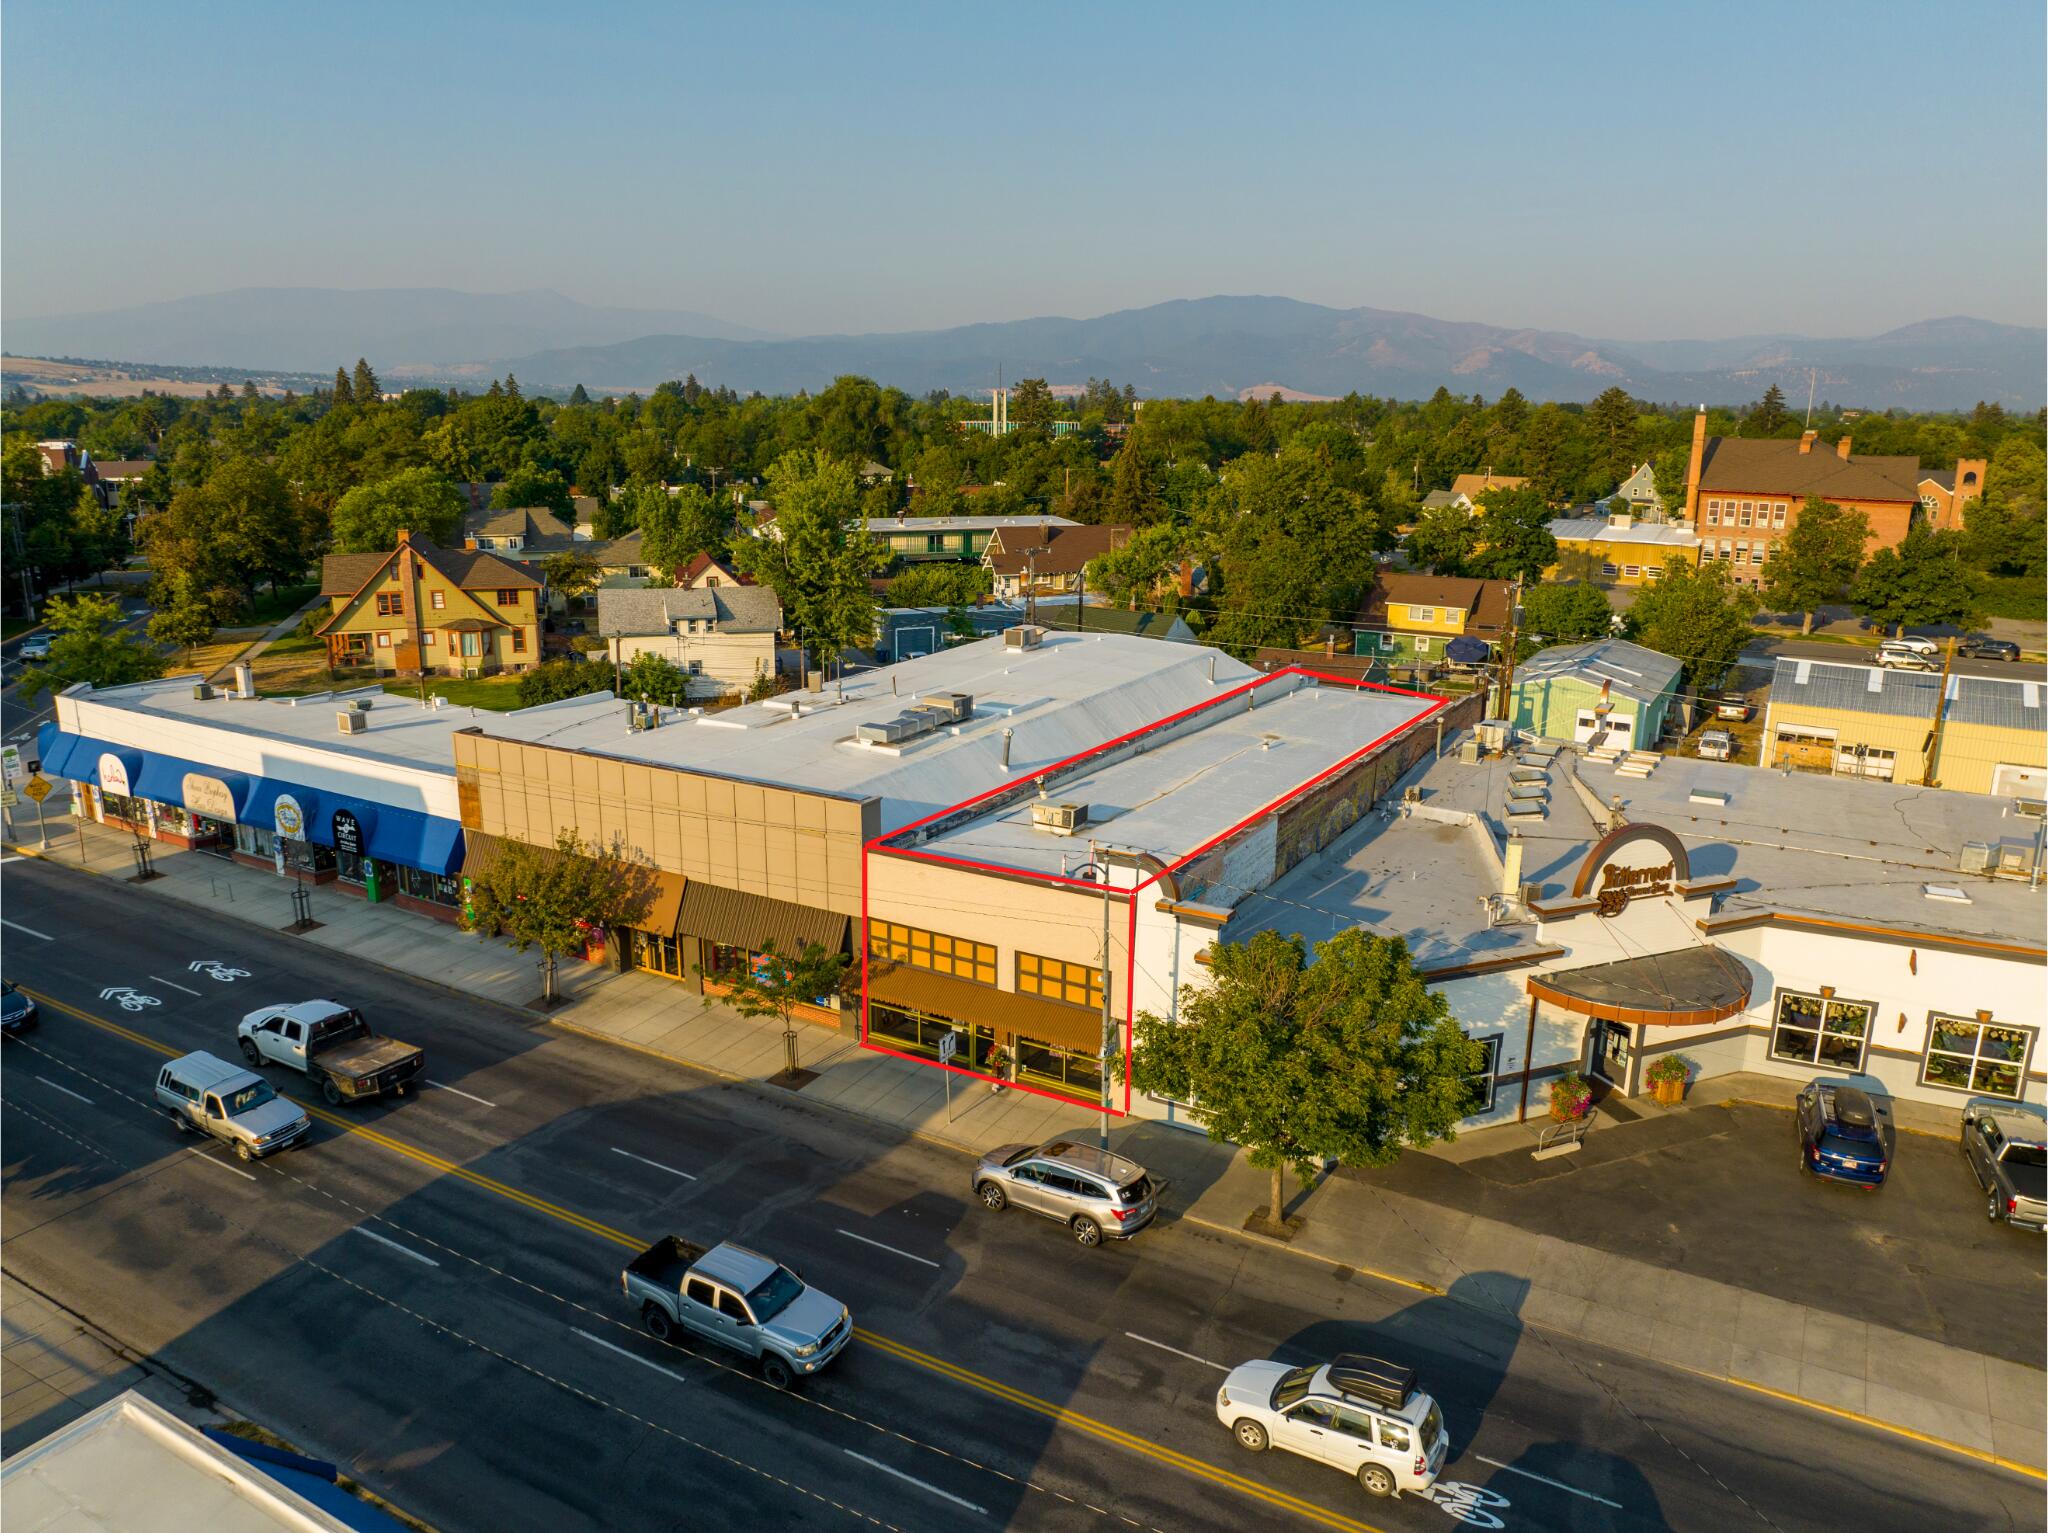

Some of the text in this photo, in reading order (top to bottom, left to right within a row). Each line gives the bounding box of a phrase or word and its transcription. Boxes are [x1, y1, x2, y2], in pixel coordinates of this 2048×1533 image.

[335, 815, 356, 826] WAVE
[337, 831, 357, 842] CIRCUIT
[1601, 860, 1675, 890] Bitterroot
